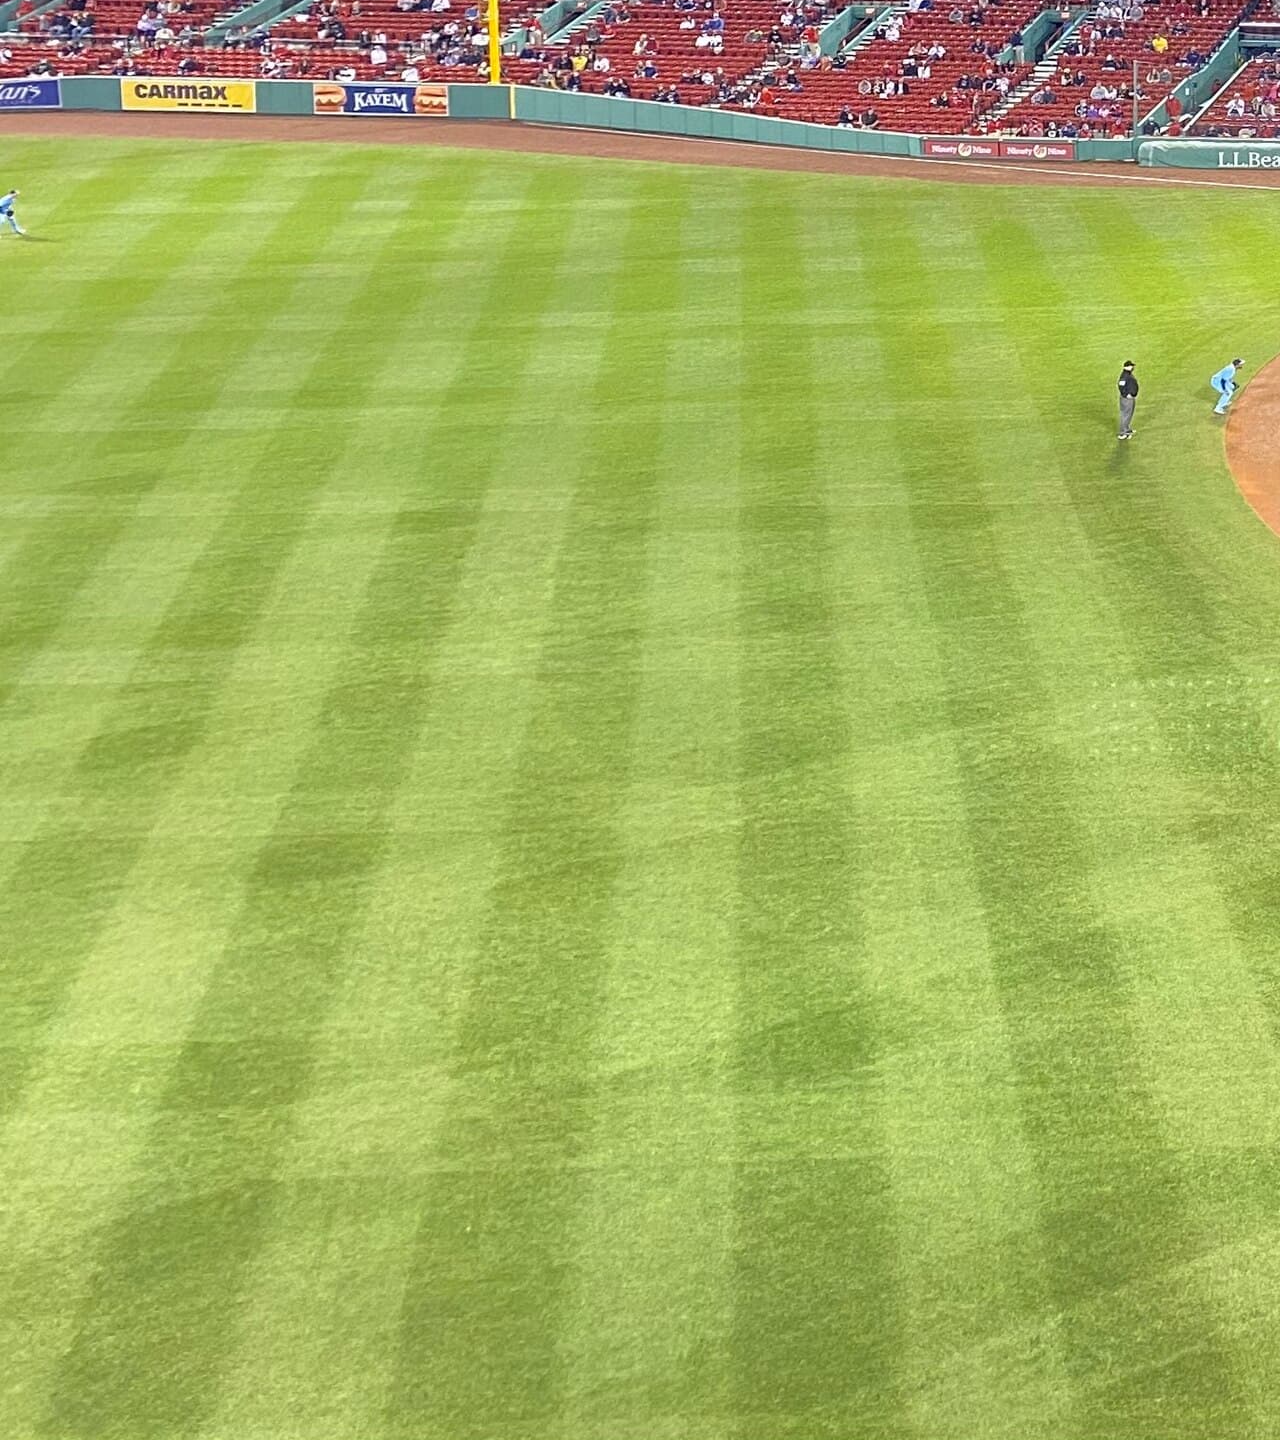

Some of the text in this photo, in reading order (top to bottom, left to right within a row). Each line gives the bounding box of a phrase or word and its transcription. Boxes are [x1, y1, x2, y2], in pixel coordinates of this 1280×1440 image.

[353, 92, 408, 113] KAYEM
[931, 144, 992, 154] Ninety Nine
[1006, 146, 1067, 156] Ninety Nine
